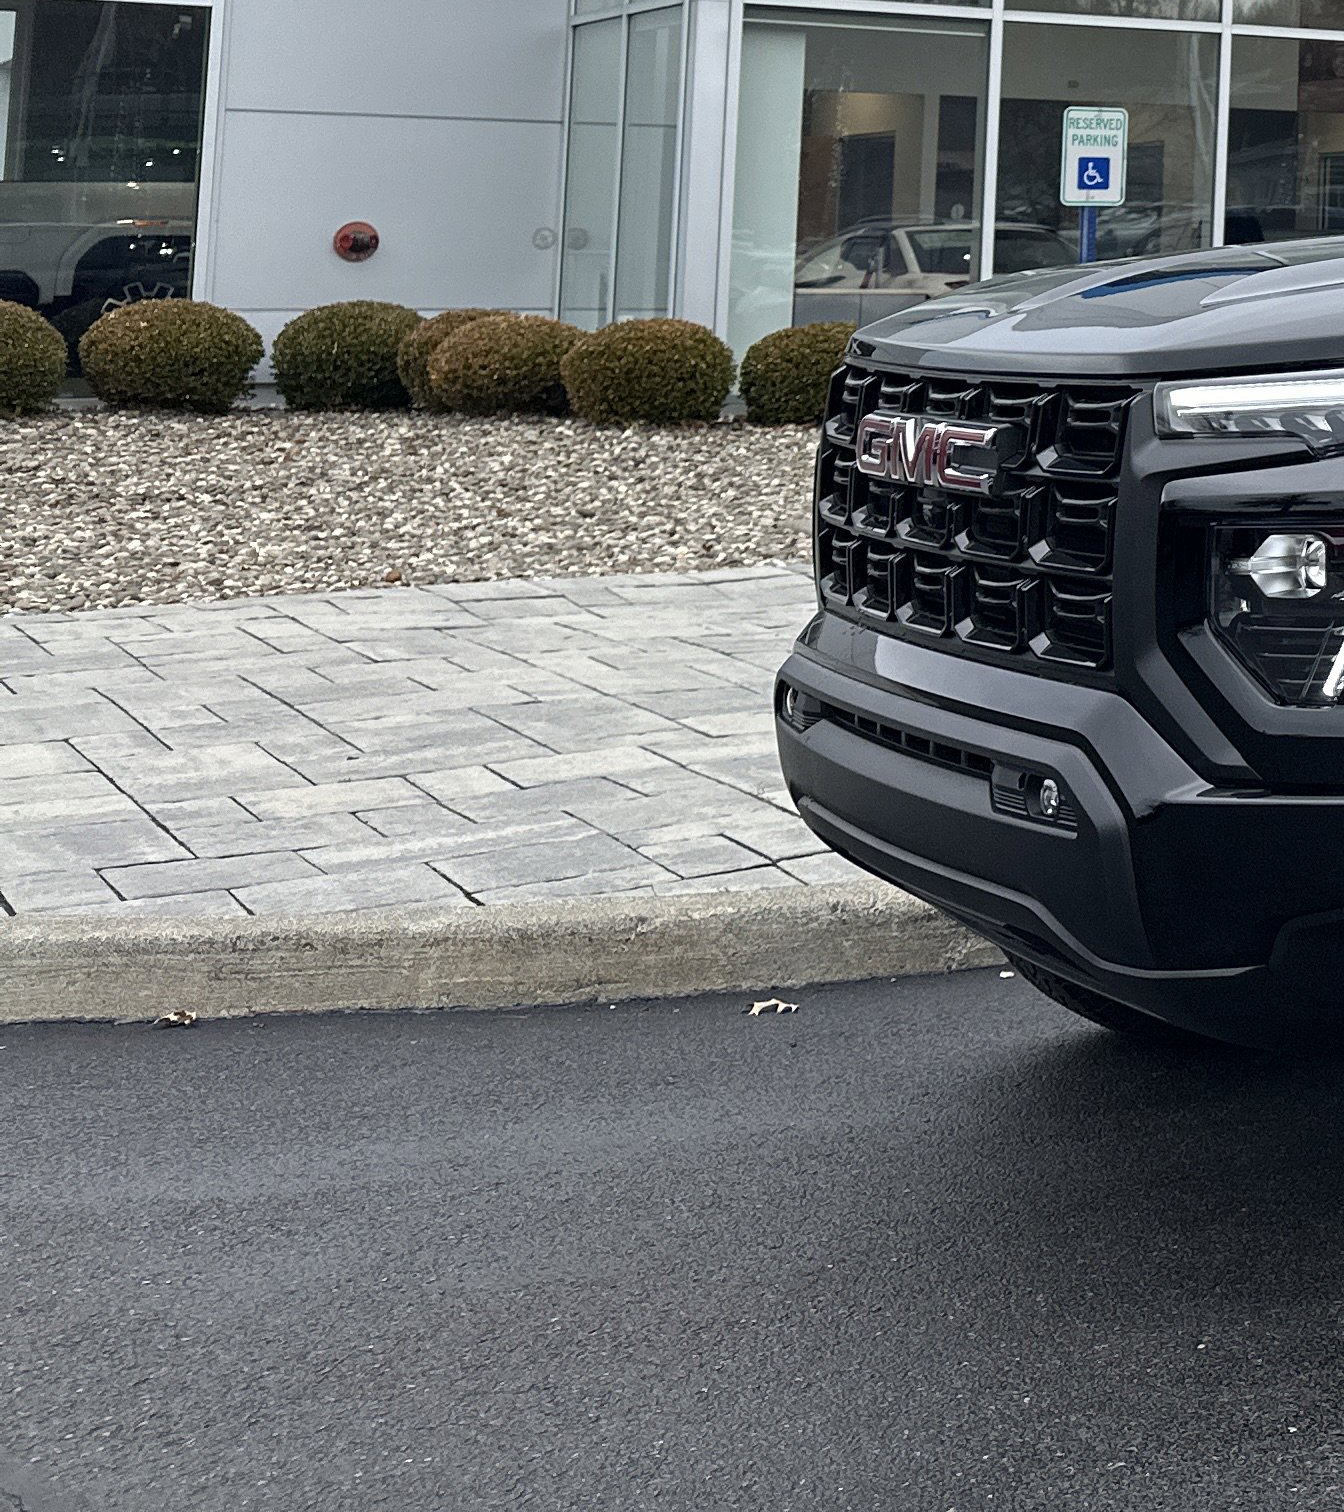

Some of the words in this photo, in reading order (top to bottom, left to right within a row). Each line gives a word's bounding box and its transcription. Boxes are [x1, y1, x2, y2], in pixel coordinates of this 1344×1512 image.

[1068, 117, 1123, 131] RESERVED
[1071, 133, 1119, 147] PARKING
[856, 413, 998, 495] GMC
